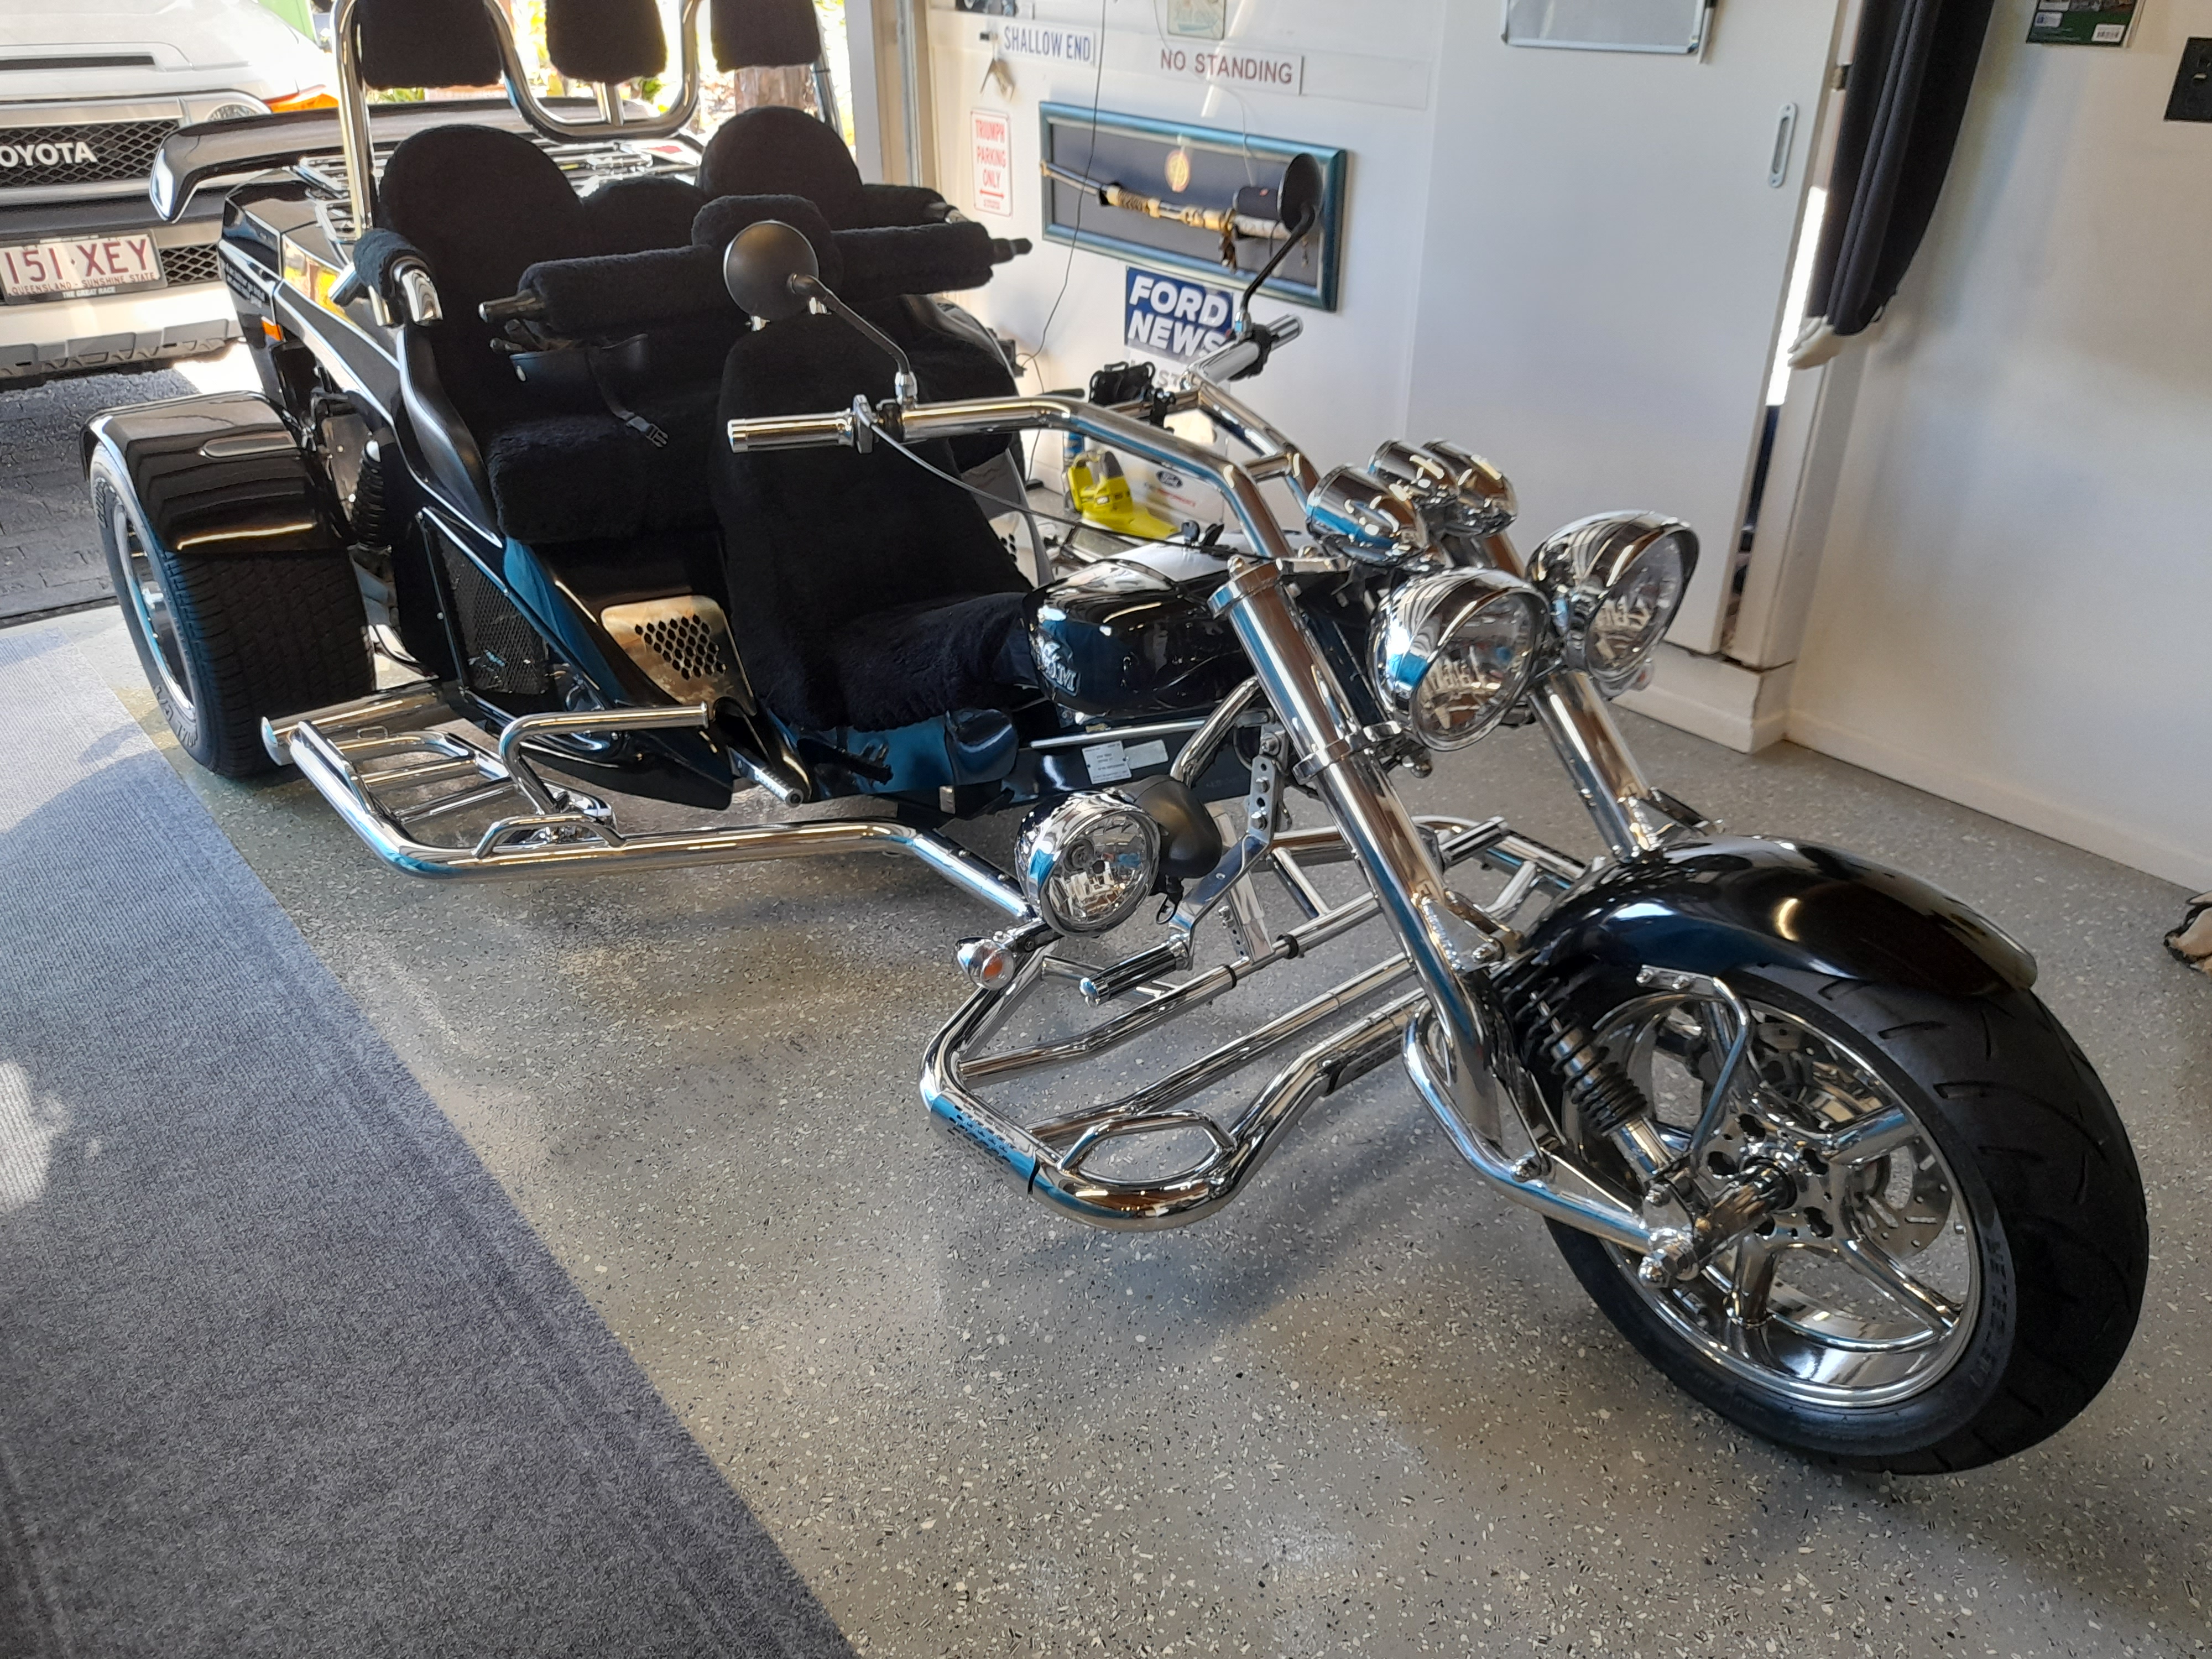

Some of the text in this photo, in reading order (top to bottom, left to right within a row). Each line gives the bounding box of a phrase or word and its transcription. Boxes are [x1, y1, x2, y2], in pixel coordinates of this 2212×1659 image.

[1004, 26, 1091, 61] SHALLOW END
[1160, 48, 1292, 84] NO STANDING
[975, 119, 1005, 143] TRIUMPH
[0, 142, 98, 168] OYOTA
[977, 145, 1006, 169] PARKING
[983, 168, 1001, 189] ONLY
[11, 281, 72, 295] QUEENSLAND
[82, 275, 126, 288] SUNSHINE
[130, 272, 156, 282] STATE
[62, 290, 75, 299] THE
[1129, 274, 1229, 327] FORD
